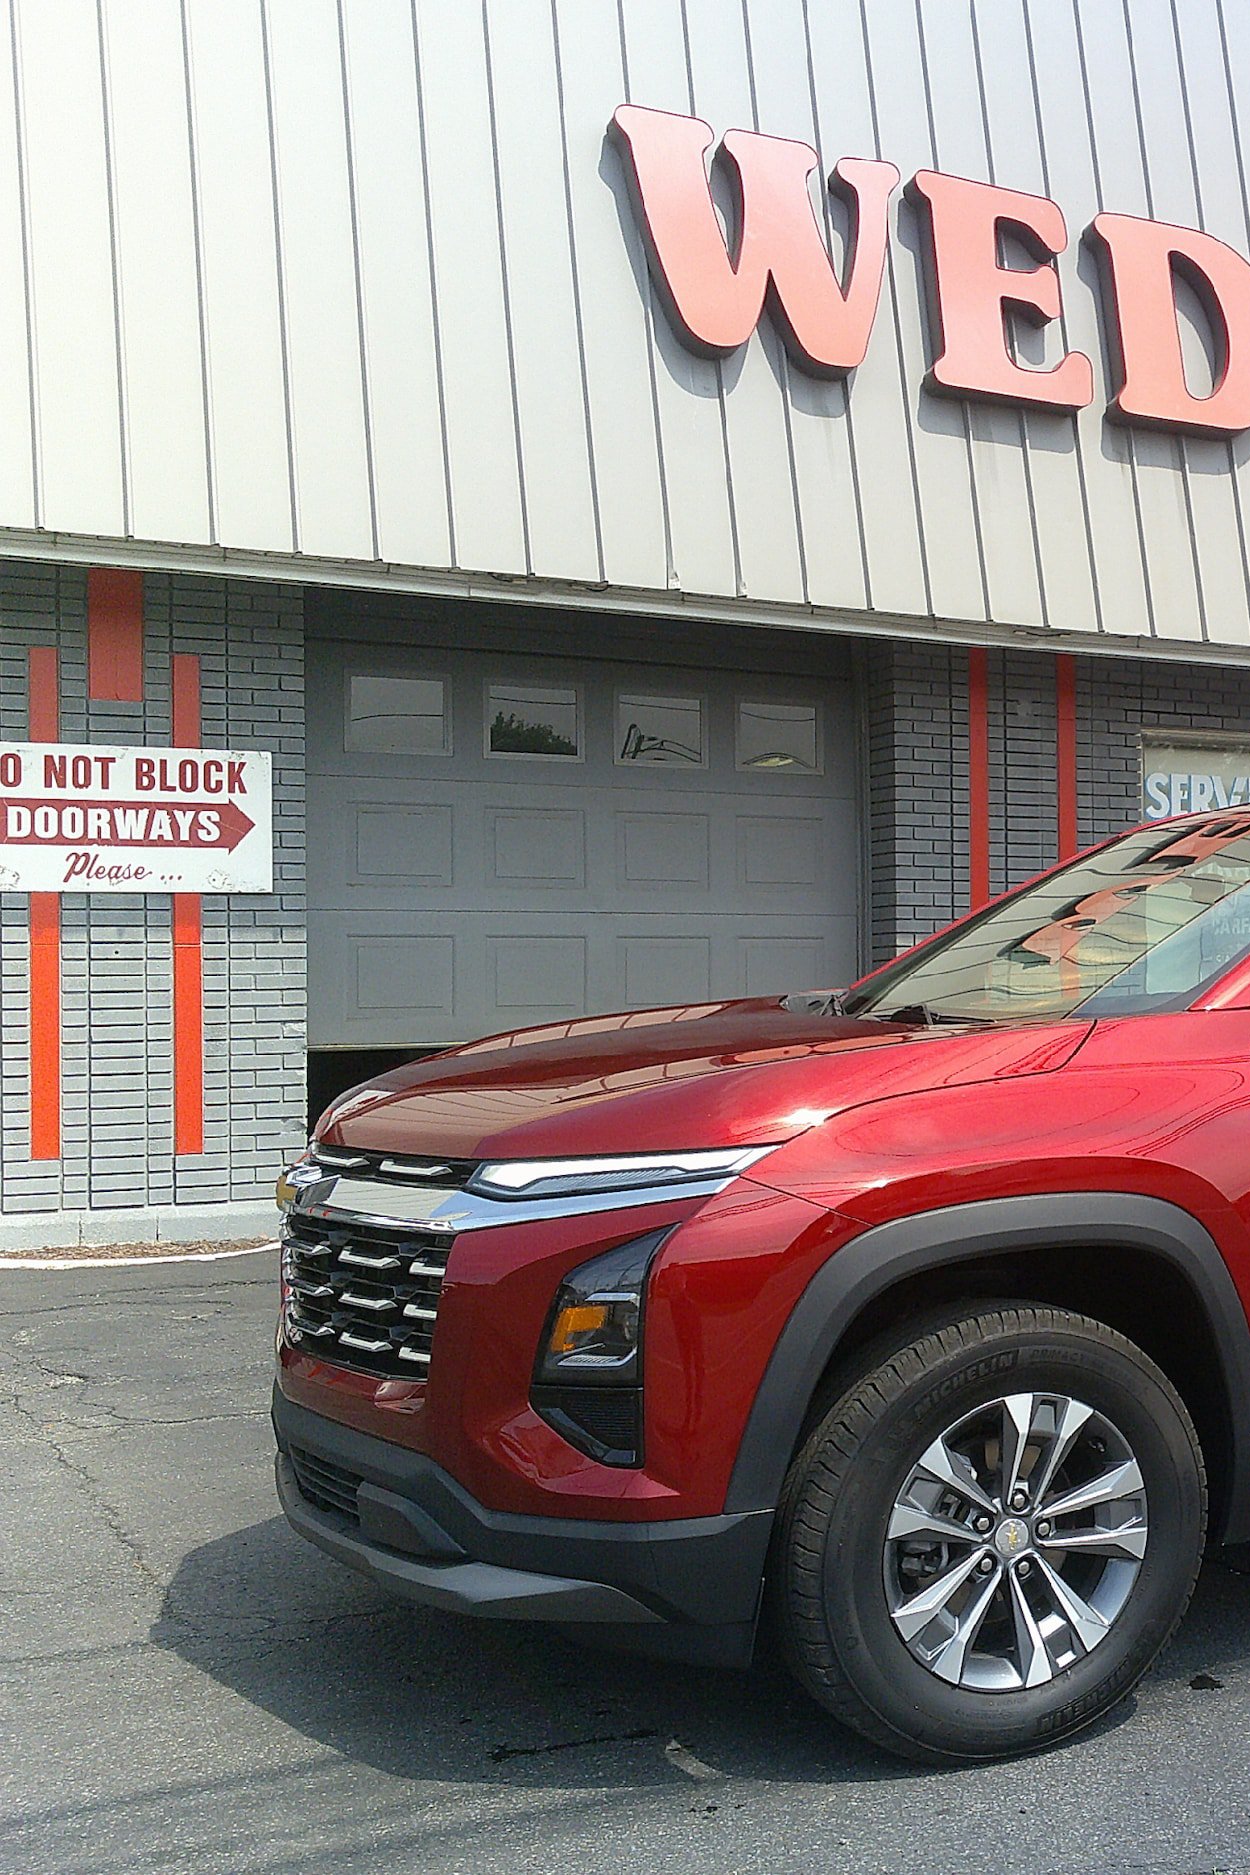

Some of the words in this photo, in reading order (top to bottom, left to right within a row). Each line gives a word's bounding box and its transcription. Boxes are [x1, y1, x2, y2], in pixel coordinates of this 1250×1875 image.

[0, 753, 22, 788] O
[44, 754, 116, 790] NOT
[135, 758, 248, 794] BLOCK
[7, 805, 221, 842] DOORWAYS
[63, 852, 153, 883] Please
